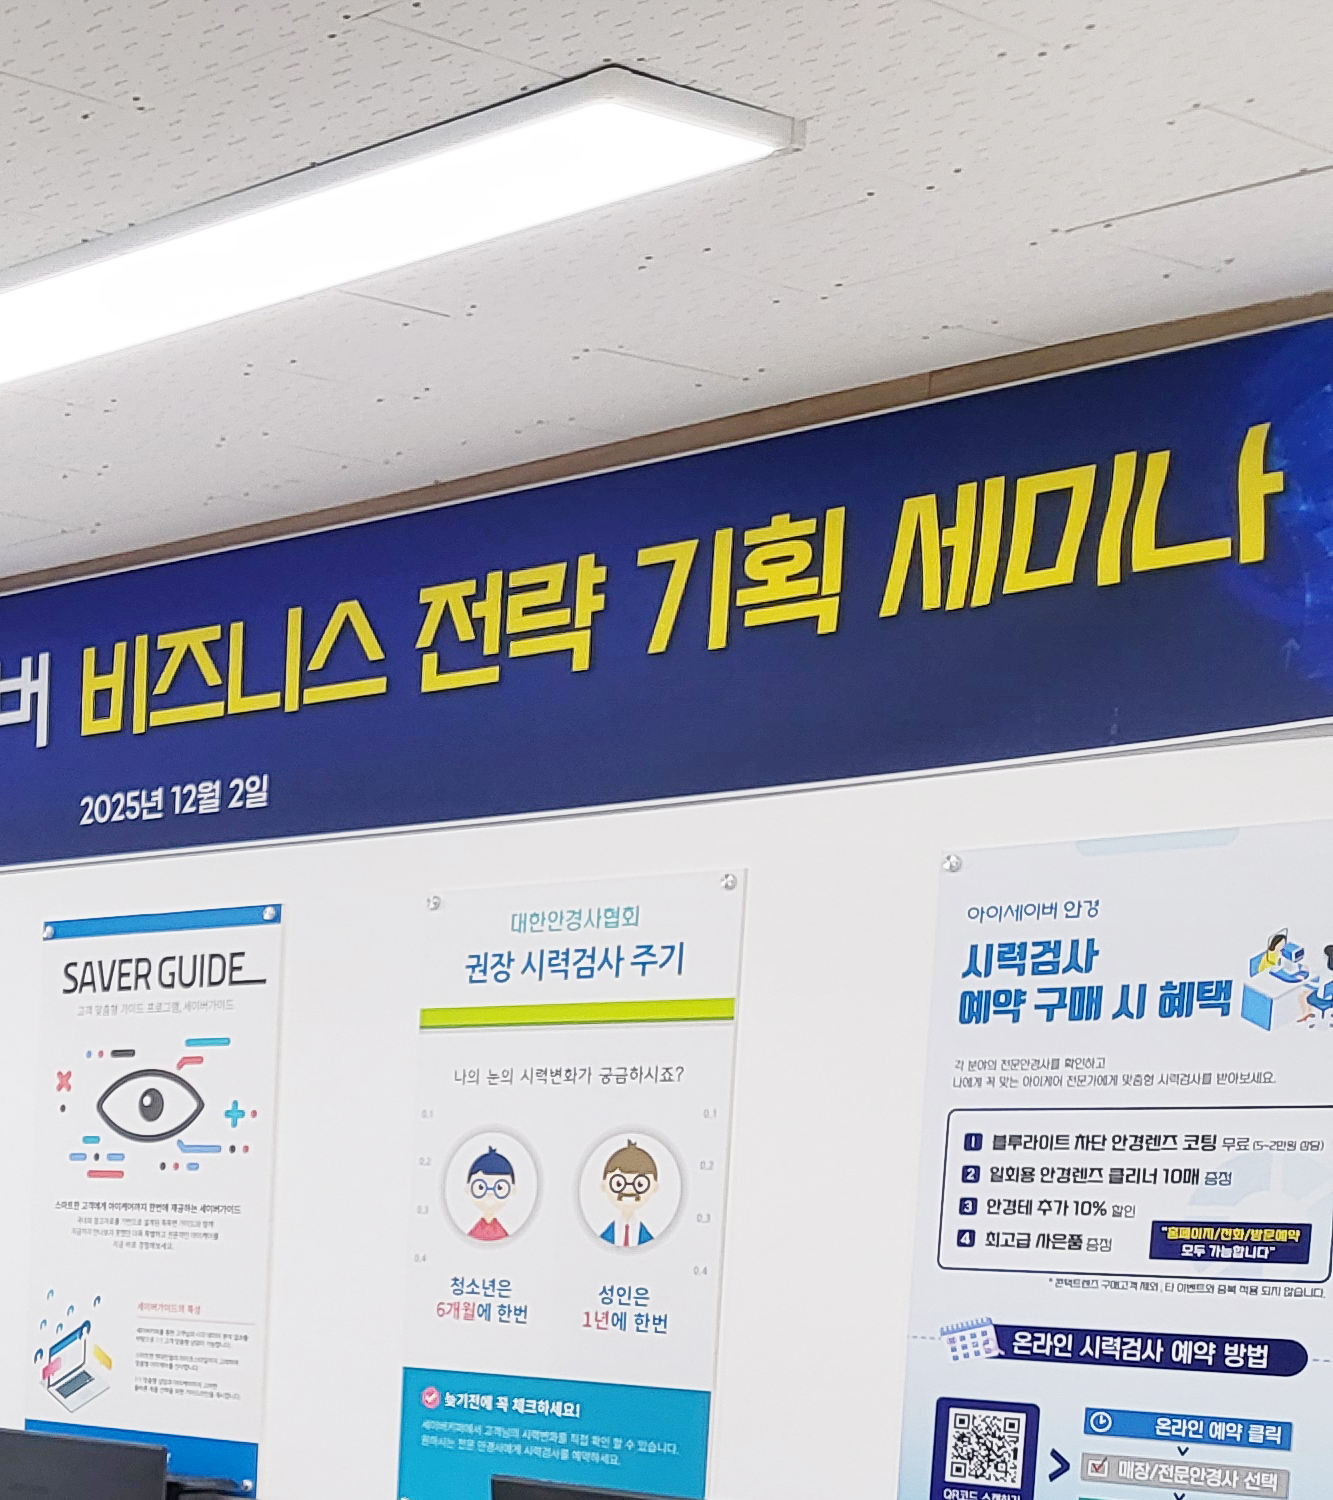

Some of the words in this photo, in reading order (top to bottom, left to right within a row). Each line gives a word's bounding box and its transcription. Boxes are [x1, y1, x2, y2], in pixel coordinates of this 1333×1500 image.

[80, 599, 387, 736] 비즈니스
[415, 553, 606, 694] 전략
[635, 506, 847, 655] 기획
[880, 422, 1285, 620] 세미나
[79, 786, 164, 826] 2025년
[170, 780, 221, 816] 12월
[228, 773, 270, 809] 2일
[510, 905, 641, 934] 대한안경사협회
[967, 901, 1058, 924] 아이세이버
[1063, 899, 1100, 919] 안경
[465, 951, 515, 985] 권장
[520, 945, 624, 982] 시력검사
[630, 941, 685, 977] 주기
[961, 937, 1100, 979] 시력검사
[62, 957, 152, 995] SAVER
[157, 951, 267, 989] GUIDE
[958, 986, 1027, 1025] 예약
[1033, 985, 1104, 1022] 구매
[1112, 983, 1148, 1020] 시
[1158, 979, 1233, 1019] 혜택
[454, 1067, 480, 1085] 나의
[486, 1067, 514, 1085] 눈의
[520, 1065, 593, 1086] 시력변화가
[598, 1064, 685, 1085] 궁금하시죠?
[1158, 1072, 1212, 1085] 시력검사를
[1216, 1071, 1277, 1085] 받아보세요.
[992, 1133, 1071, 1152] 블루라이트
[1073, 1133, 1108, 1152] 차단
[1111, 1133, 1179, 1152] 안경렌즈
[1182, 1133, 1218, 1152] 코팅
[1221, 1136, 1251, 1152] 무료
[989, 1165, 1036, 1183] 일회용
[1040, 1166, 1104, 1184] 안경렌즈
[1108, 1166, 1158, 1185] 클리너
[1163, 1168, 1200, 1186] 10매
[986, 1198, 1033, 1217] 안경테
[1036, 1199, 1069, 1217] 추가
[1073, 1200, 1108, 1217] 10%
[984, 1231, 1031, 1250] 최고급
[1035, 1232, 1083, 1251] 사은품
[1181, 1244, 1206, 1258] 모두
[450, 1276, 512, 1299] 청소년은
[598, 1285, 650, 1306] 성인은
[436, 1301, 492, 1322] 6개월에
[497, 1303, 528, 1325] 한번
[583, 1310, 627, 1332] 1년에
[634, 1313, 669, 1335] 한번
[1012, 1332, 1073, 1358] 온라인
[1079, 1334, 1164, 1363] 시력검사
[1171, 1338, 1216, 1366] 예약
[1223, 1342, 1269, 1369] 방법
[496, 1395, 509, 1413] 꼭
[511, 1396, 581, 1419] 체크하세요!
[1154, 1416, 1205, 1440] 온라인
[1208, 1420, 1244, 1442] 예약
[1248, 1424, 1282, 1445] 클릭
[1118, 1460, 1239, 1488] 매장/전문안경사
[1243, 1471, 1278, 1492] 선택
